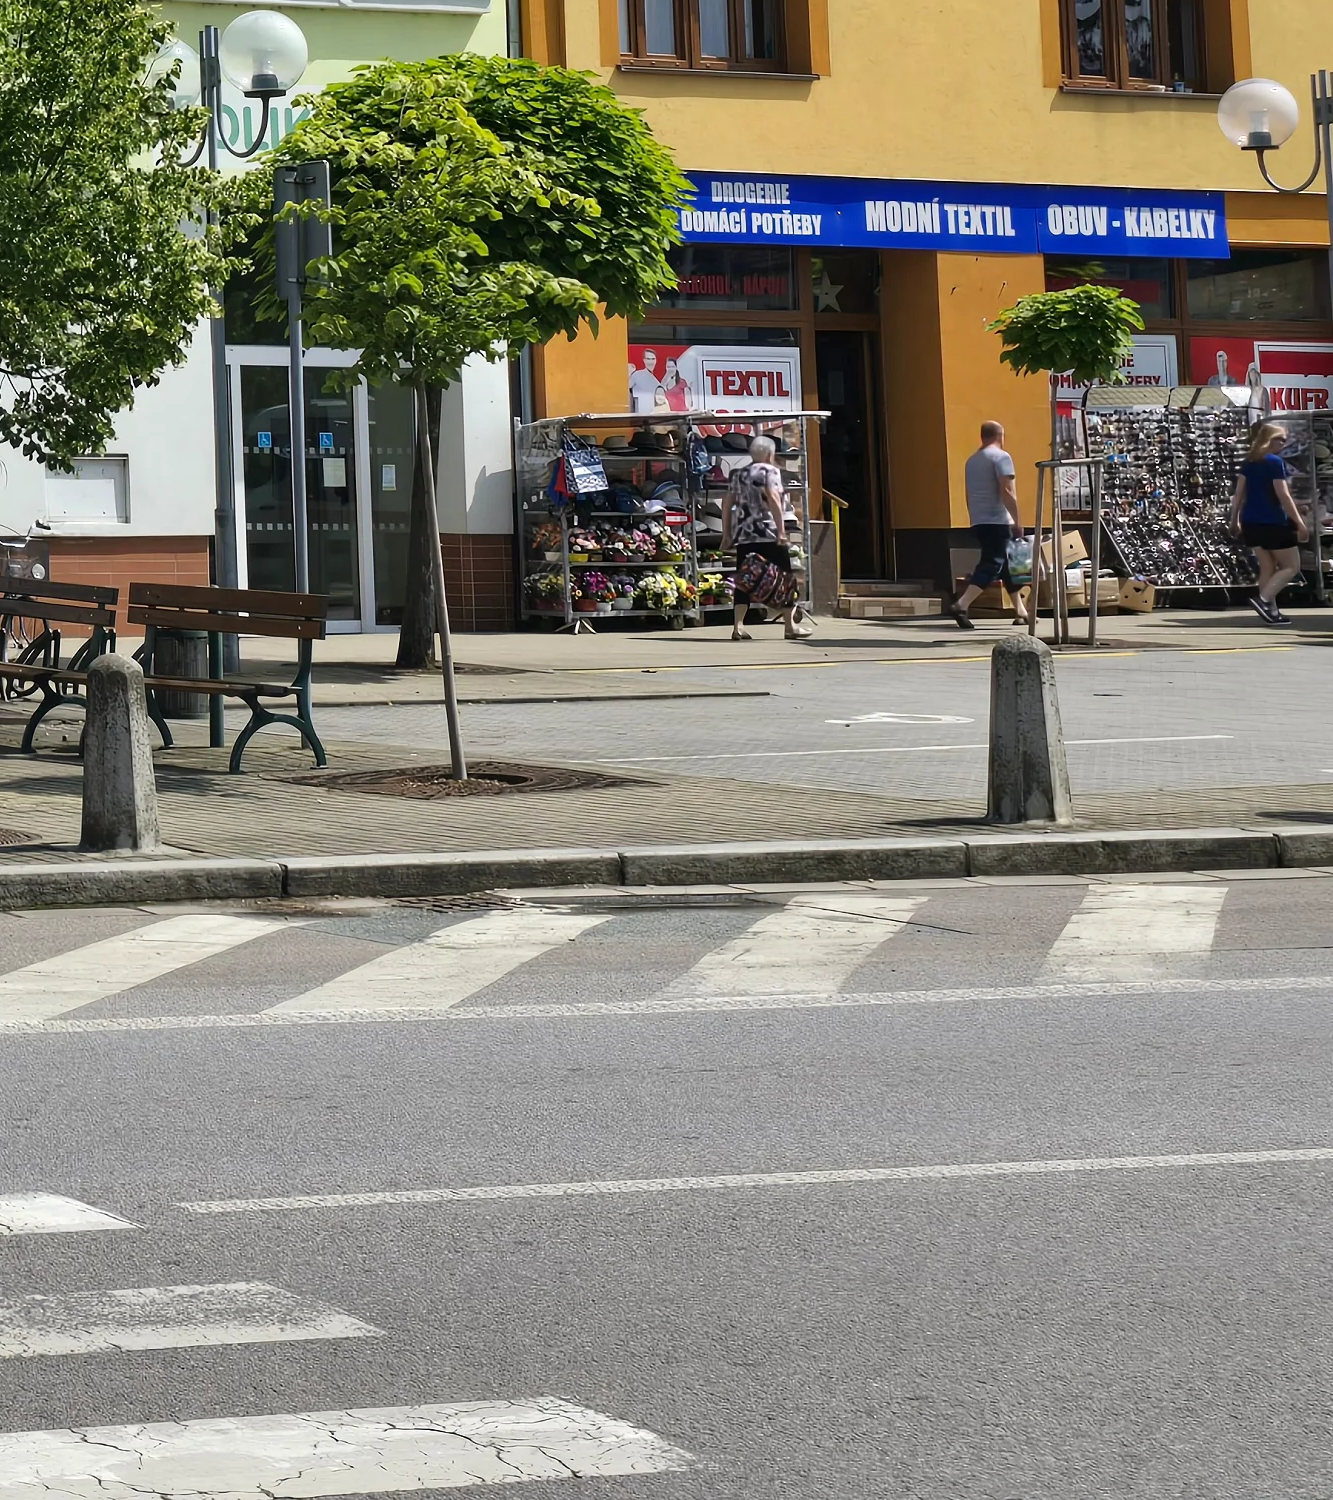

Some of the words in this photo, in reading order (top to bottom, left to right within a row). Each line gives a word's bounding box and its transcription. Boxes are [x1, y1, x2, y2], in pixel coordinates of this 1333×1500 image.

[711, 181, 791, 205] DROGERIE
[681, 208, 747, 233] DOMÁCÍ
[751, 210, 822, 236] POTŘEBY
[865, 197, 940, 234] MODNÍ
[944, 204, 1016, 237] TEXTIL
[1047, 204, 1108, 237] OBUV
[1124, 206, 1216, 239] KABELKY
[706, 370, 790, 397] TEXTIL
